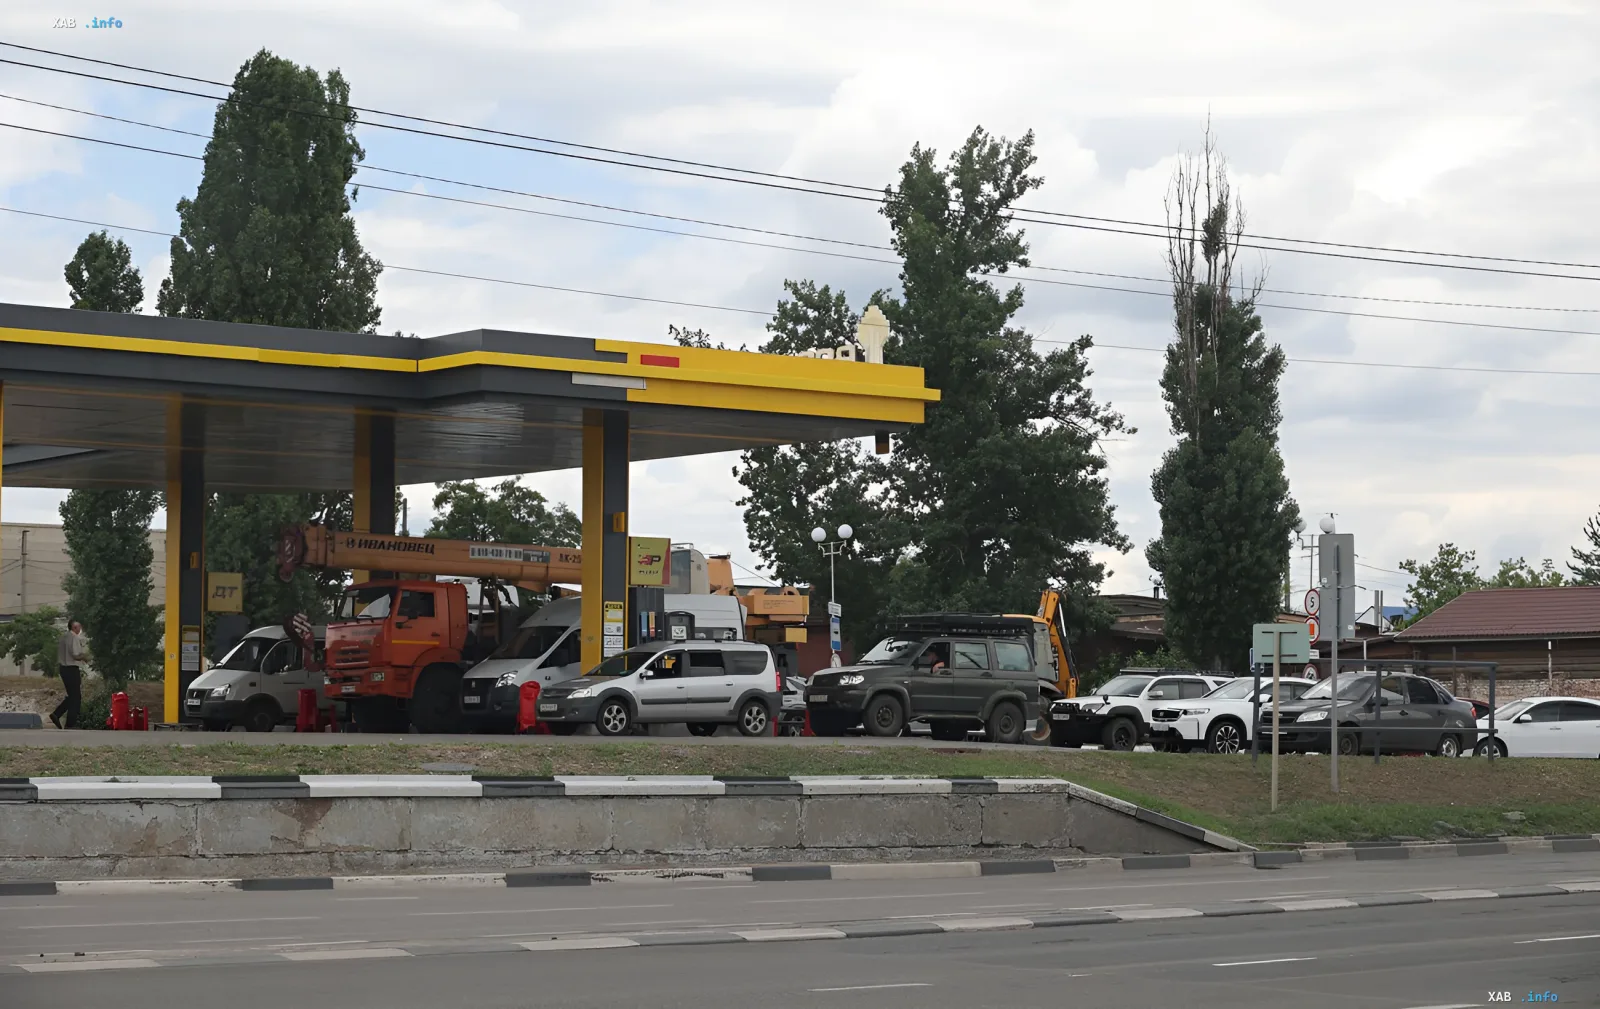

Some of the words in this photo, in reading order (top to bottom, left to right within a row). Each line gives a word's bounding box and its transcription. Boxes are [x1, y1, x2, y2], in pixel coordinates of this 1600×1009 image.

[357, 538, 435, 555] ИВАНОВЕЦ
[212, 586, 238, 598] ДТ
[1310, 597, 1315, 608] 5
